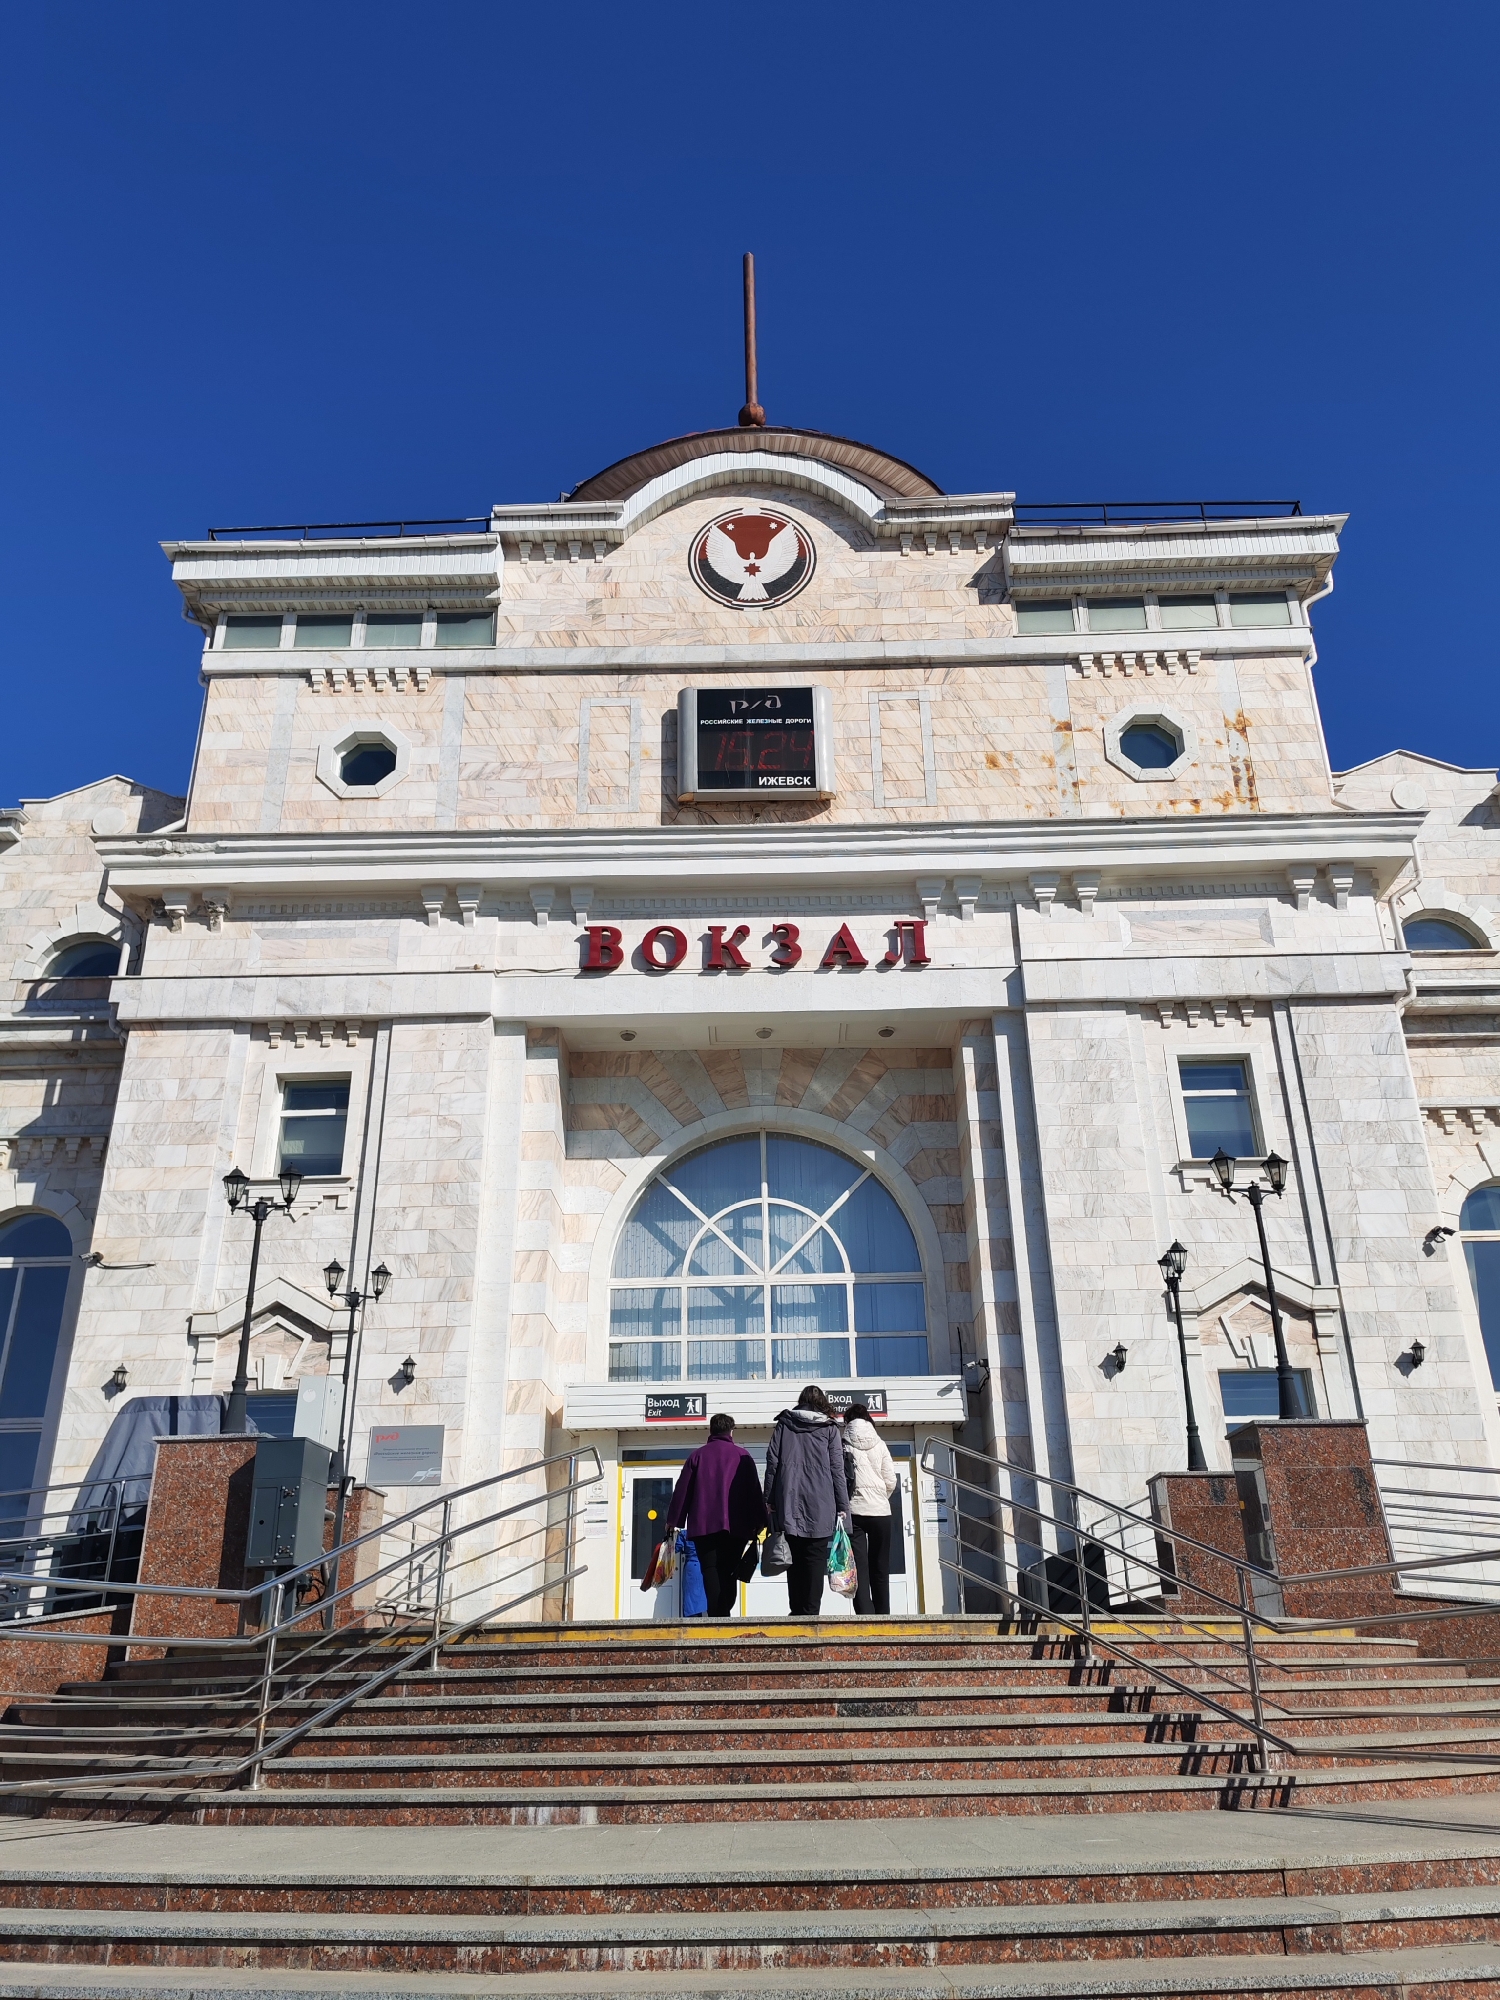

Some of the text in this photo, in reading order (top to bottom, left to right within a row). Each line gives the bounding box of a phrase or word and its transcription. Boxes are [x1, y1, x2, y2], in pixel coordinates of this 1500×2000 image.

[758, 776, 811, 786] ИЖЕВСК
[583, 920, 932, 971] ВОКЗАЛ
[647, 1397, 680, 1409] Выход
[828, 1394, 853, 1405] Вход
[647, 1408, 663, 1417] Exit
